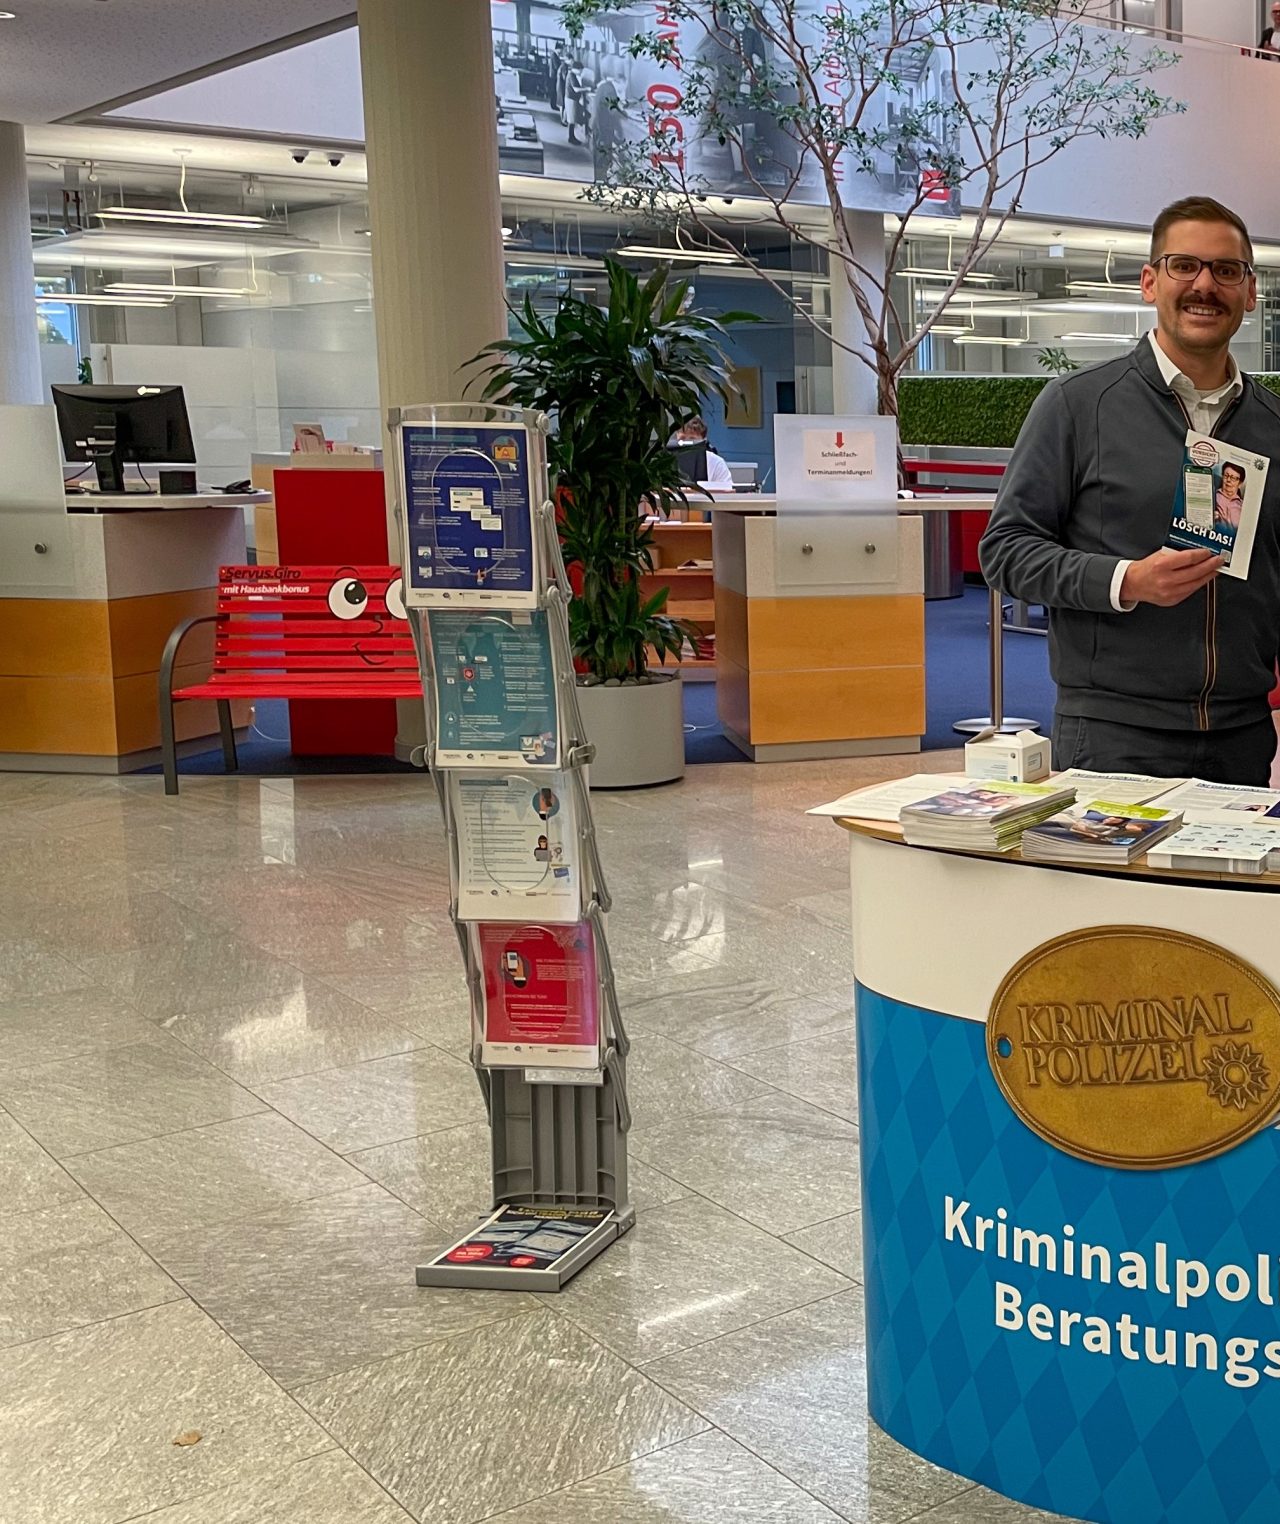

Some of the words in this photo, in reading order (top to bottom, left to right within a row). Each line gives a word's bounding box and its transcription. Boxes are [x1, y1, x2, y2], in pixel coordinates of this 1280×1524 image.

[647, 84, 685, 172] 150
[1172, 517, 1207, 536] LÖSCH
[1208, 529, 1233, 546] DAS!
[223, 585, 239, 594] mit
[240, 585, 310, 594] Hausbankbonus
[226, 567, 301, 580] Servus.Giro
[1016, 993, 1252, 1044] KRIMINAL
[1023, 1040, 1207, 1086] POLIZEI
